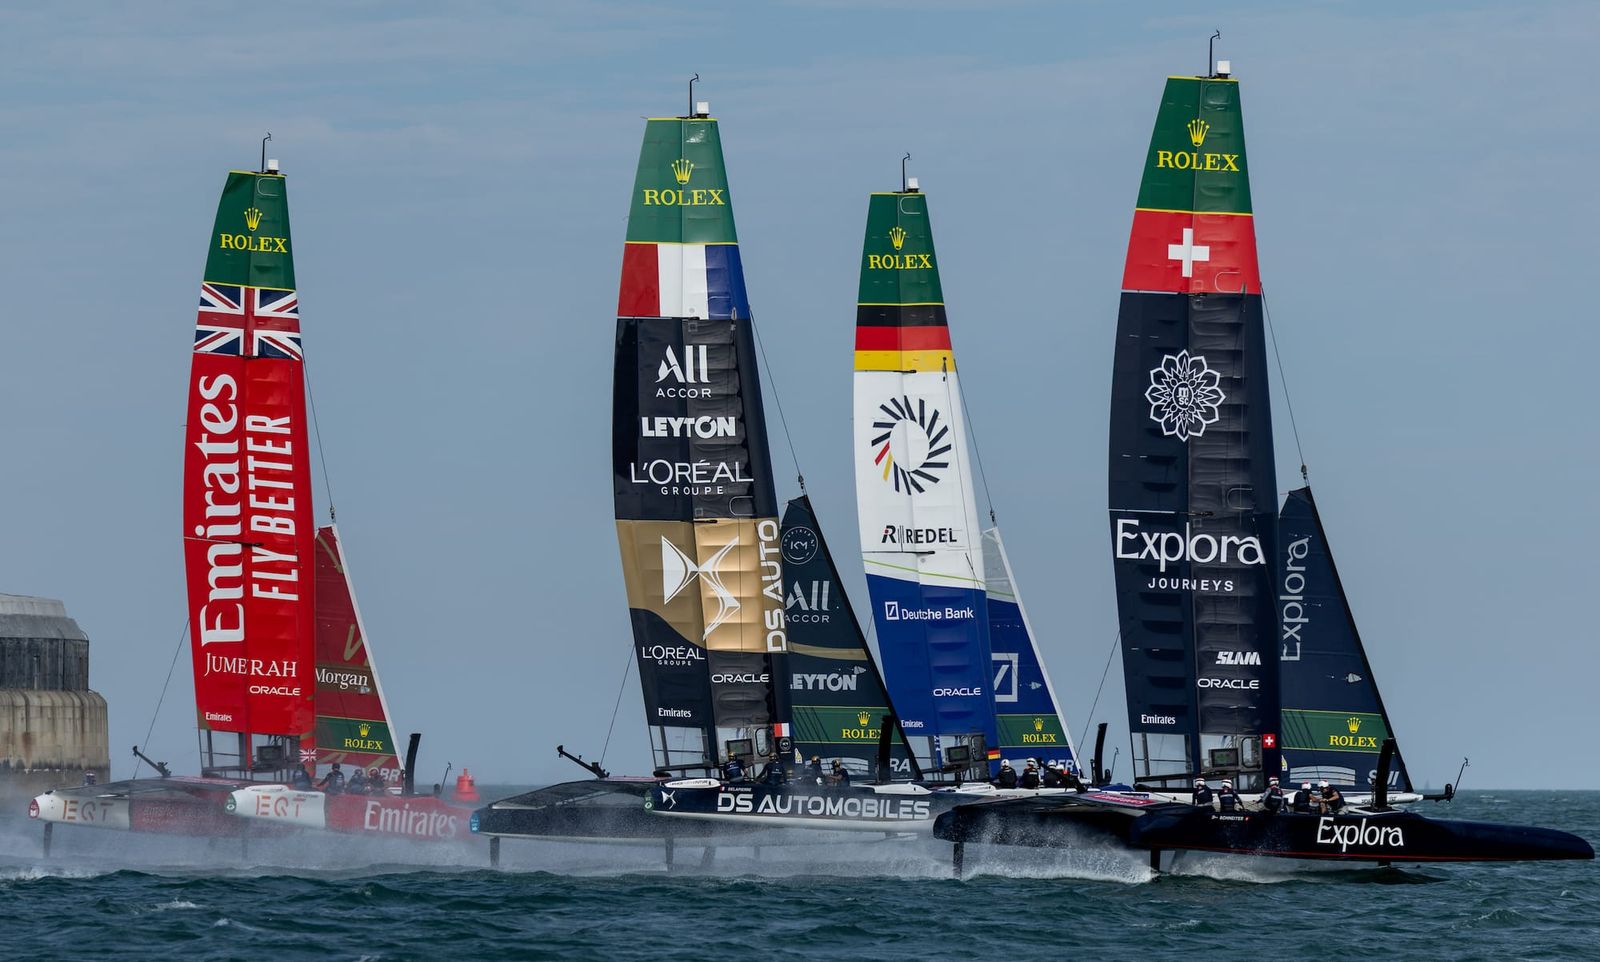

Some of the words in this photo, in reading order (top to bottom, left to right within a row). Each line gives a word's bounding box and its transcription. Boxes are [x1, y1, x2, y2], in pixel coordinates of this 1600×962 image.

[1157, 150, 1240, 172] ROLEX
[643, 189, 725, 206] ROLEX
[220, 233, 288, 253] ROLEX
[868, 254, 932, 270] ROLEX
[656, 388, 712, 399] ACCOR
[641, 415, 736, 439] LEYTON
[245, 415, 296, 536] BETTER
[661, 486, 724, 495] GROUPE
[194, 373, 245, 647] Emirates
[1116, 518, 1266, 572] Explora
[757, 519, 783, 603] AUTO
[252, 545, 299, 601] FLY
[1148, 577, 1234, 592] JOURNEYS
[1279, 537, 1310, 662] Explora
[784, 614, 830, 623] ACCOR
[945, 606, 974, 619] Bank
[764, 608, 787, 652] DS
[315, 667, 368, 690] Morgan
[711, 673, 770, 683] ORACLE
[790, 673, 857, 691] EYTON
[1197, 678, 1260, 689] ORACLE
[249, 685, 302, 696] ORACLE
[933, 687, 982, 697] ORACLE
[205, 711, 232, 722] Emirates
[658, 707, 692, 718] Emirates
[1141, 714, 1176, 725] Emirates
[900, 719, 924, 728] Emirates
[344, 738, 384, 750] ROLEX
[1022, 733, 1057, 743] ROLEX
[1329, 735, 1378, 748] ROLEX
[717, 793, 754, 813] DS
[757, 795, 931, 819] AUTOMOBILES
[364, 800, 457, 838] Emirates
[1316, 816, 1404, 853] Explora
